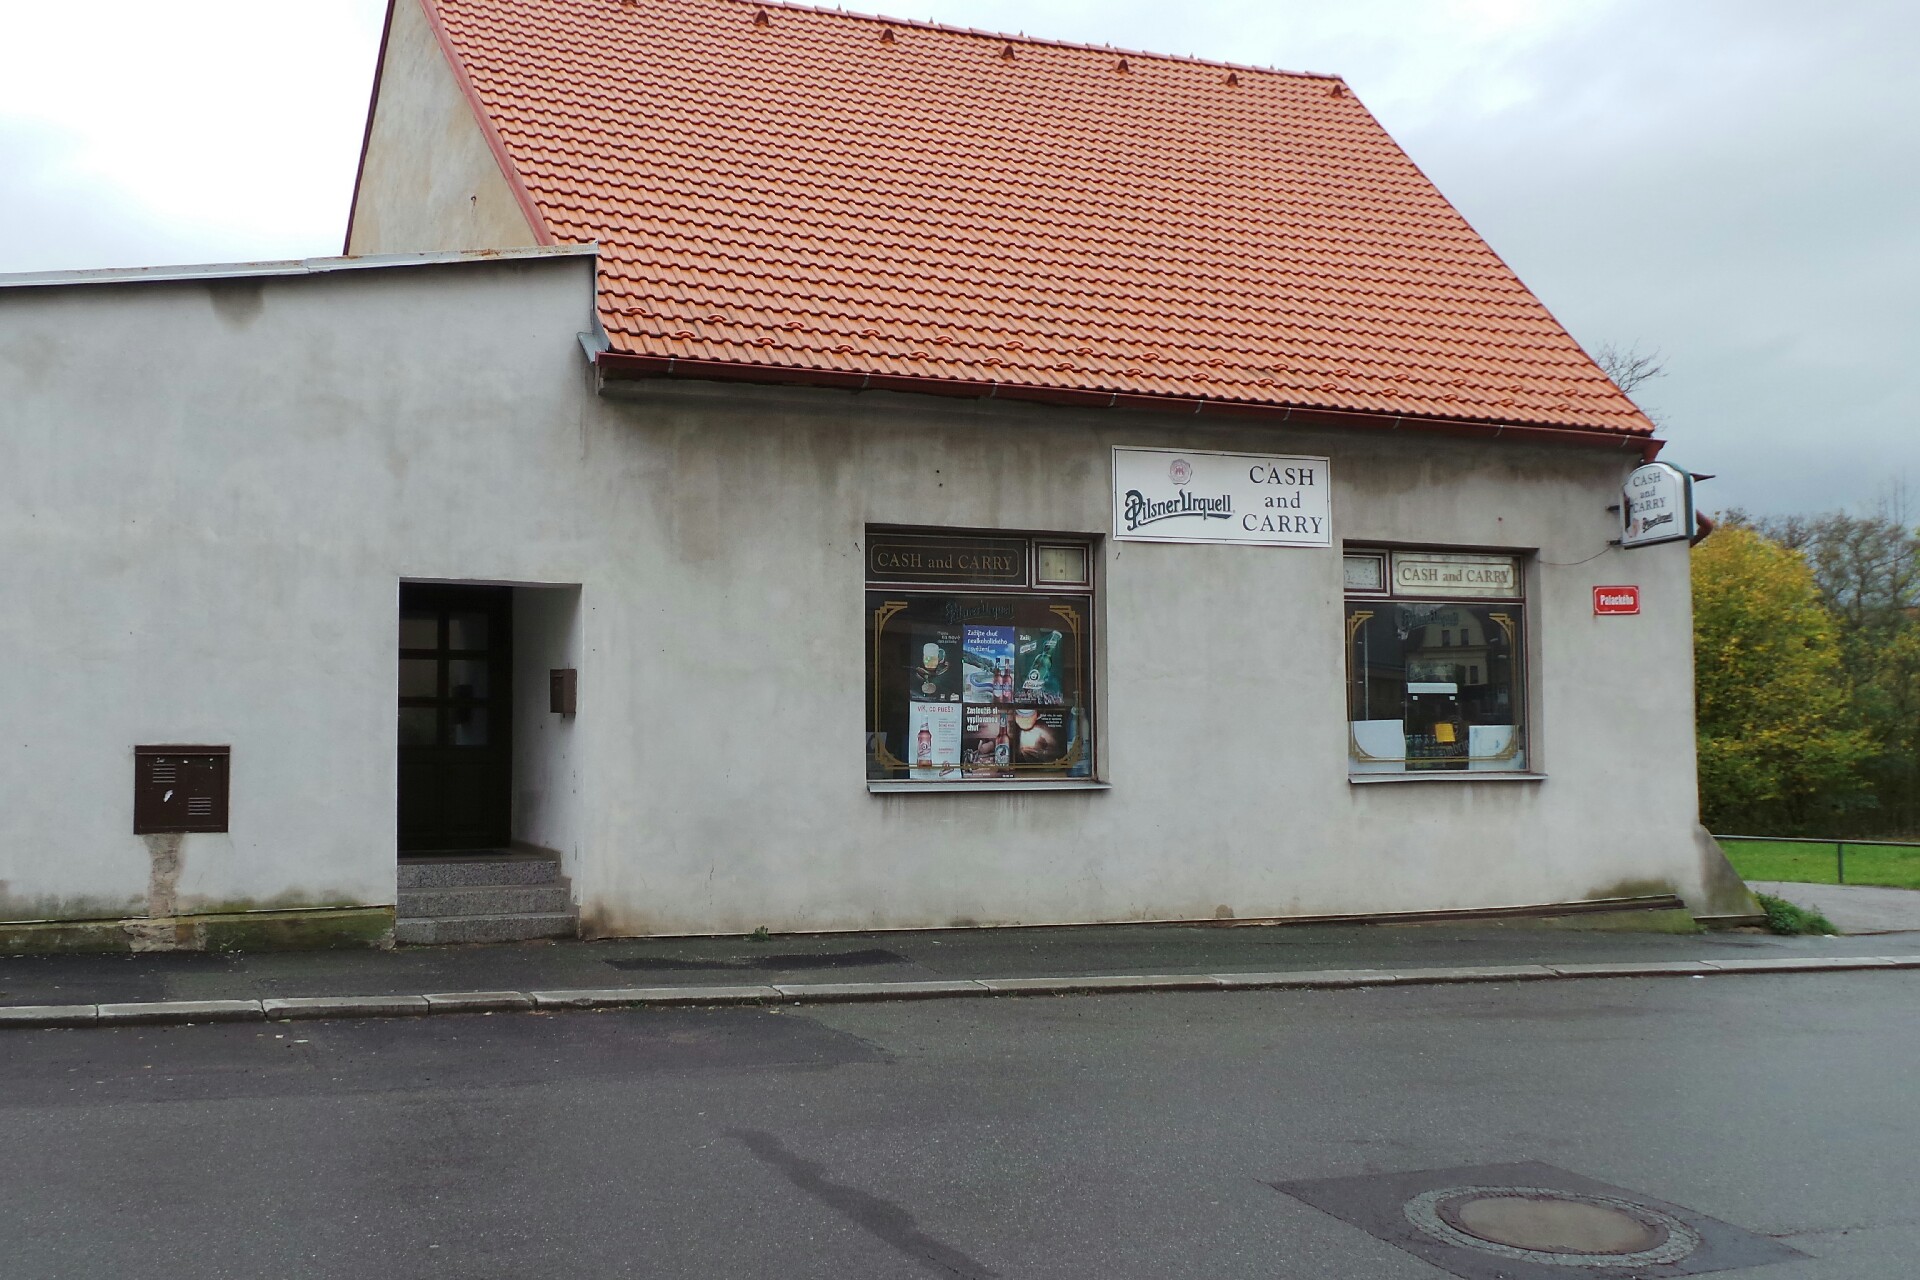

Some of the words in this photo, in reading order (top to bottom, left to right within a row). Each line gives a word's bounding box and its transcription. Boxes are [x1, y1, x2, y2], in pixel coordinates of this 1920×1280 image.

[1249, 465, 1314, 486] CASH
[1632, 472, 1661, 487] CASH
[1264, 491, 1301, 509] and
[1640, 486, 1656, 499] and
[1124, 489, 1180, 532] Pilsner
[1178, 488, 1231, 520] Urquell
[1632, 496, 1666, 514] CARRY
[1242, 513, 1323, 534] CARRY
[877, 552, 923, 568] CASH
[928, 555, 952, 569] and
[958, 555, 1012, 570] CARRY
[1402, 567, 1438, 581] CASH
[1442, 569, 1463, 582] and
[1466, 569, 1510, 584] CARRY
[1600, 594, 1634, 606] Palackého
